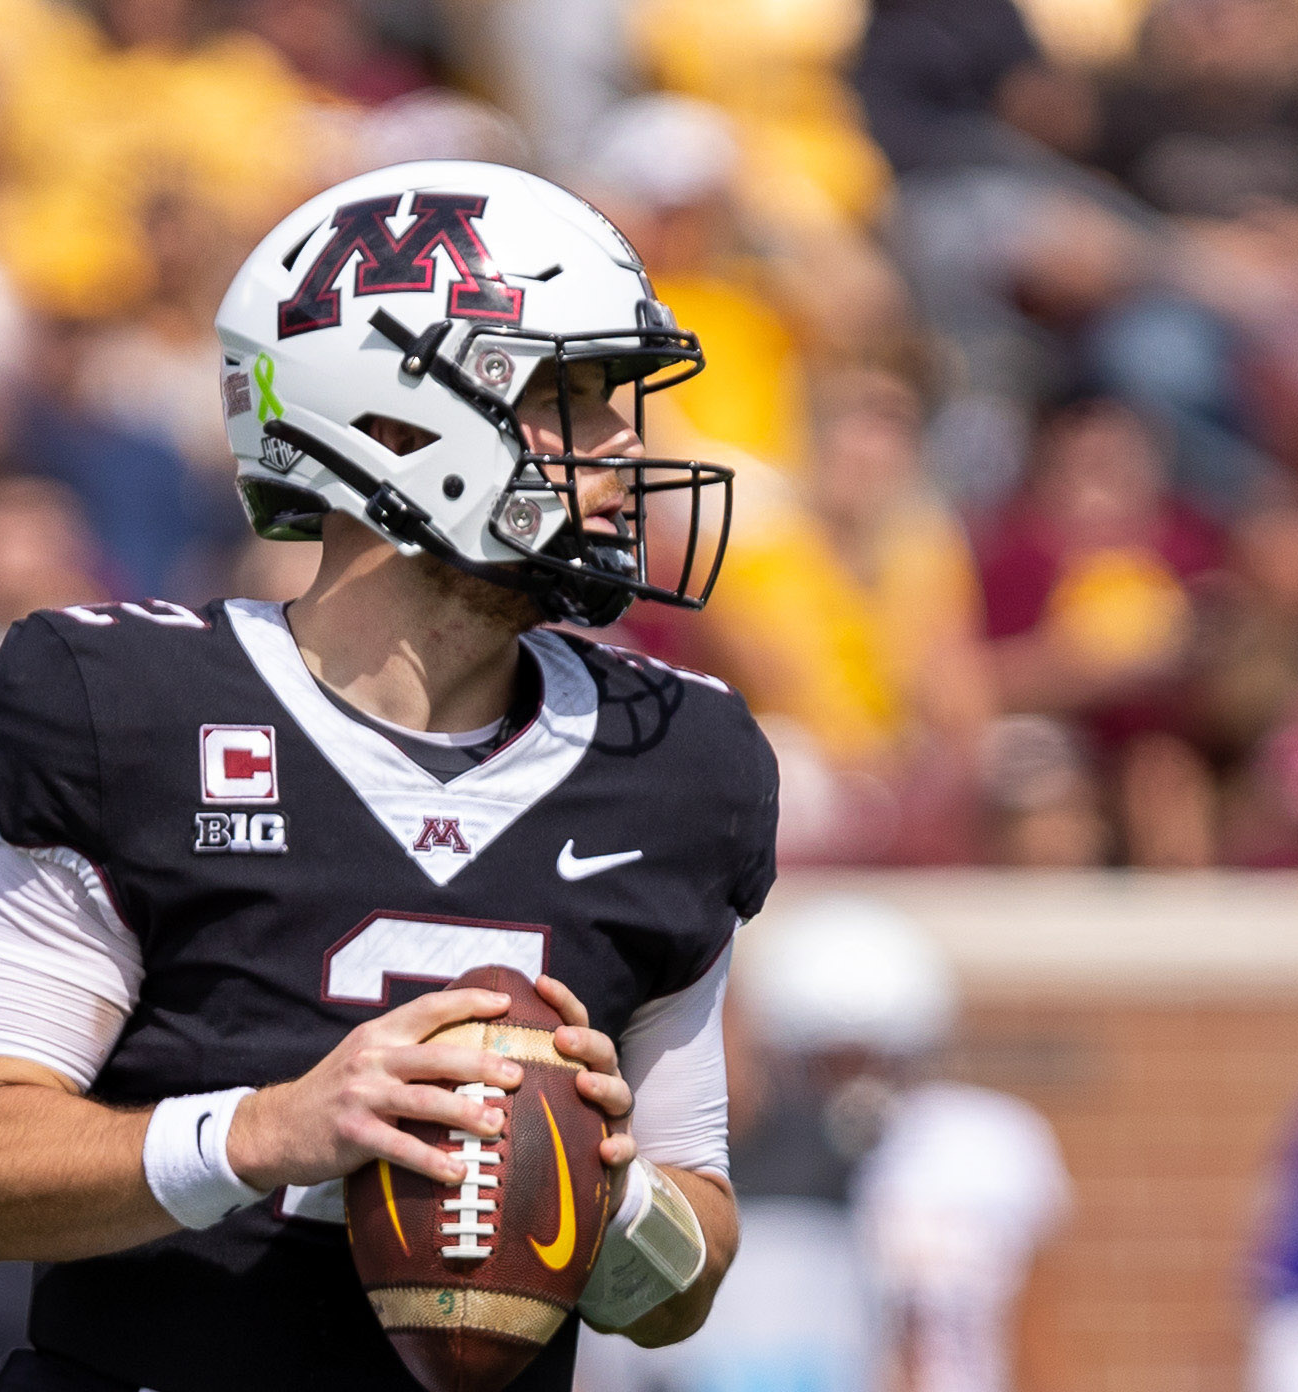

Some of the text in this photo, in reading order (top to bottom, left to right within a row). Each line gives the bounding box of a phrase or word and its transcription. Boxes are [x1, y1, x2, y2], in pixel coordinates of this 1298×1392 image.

[278, 191, 525, 340] M
[204, 728, 273, 798] C
[412, 815, 471, 854] M
